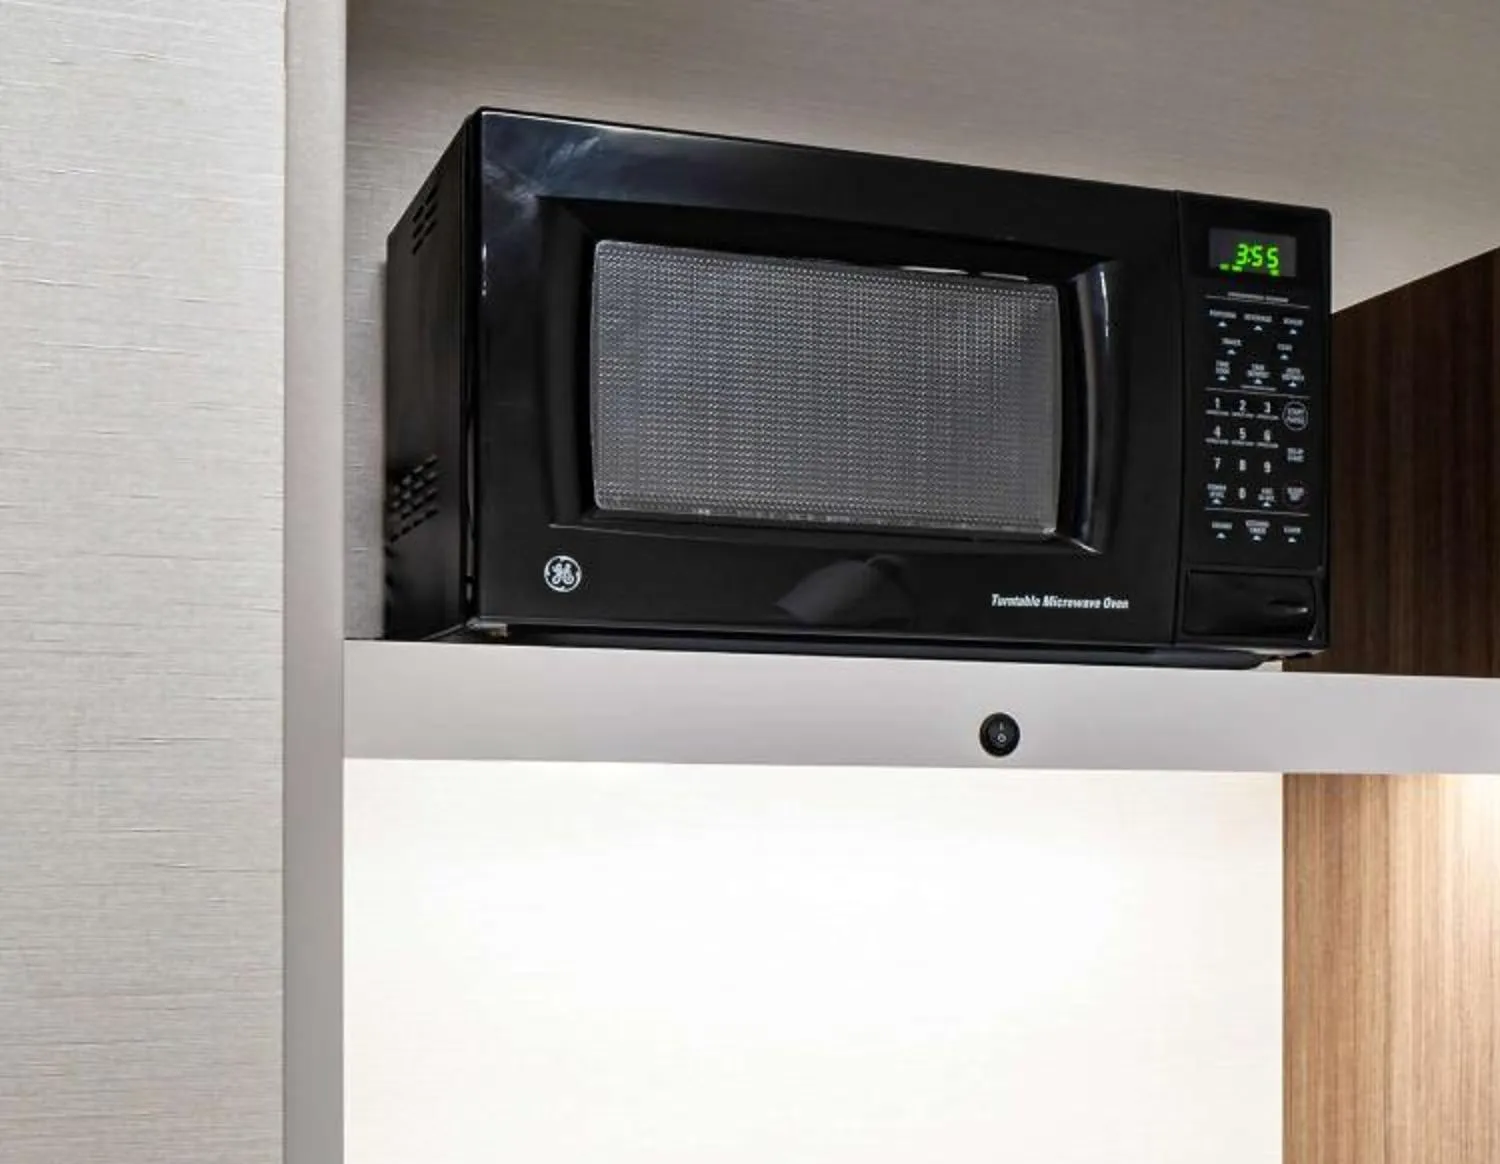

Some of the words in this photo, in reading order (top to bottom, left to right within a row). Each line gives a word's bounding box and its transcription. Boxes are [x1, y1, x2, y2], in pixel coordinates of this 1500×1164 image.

[1235, 243, 1280, 269] 3:55
[1214, 457, 1221, 470] 7
[1239, 459, 1247, 472] 8
[1264, 461, 1271, 474] 9
[991, 593, 1041, 608] Turntable
[1042, 595, 1101, 609] Microwave
[1103, 597, 1129, 609] Oven
